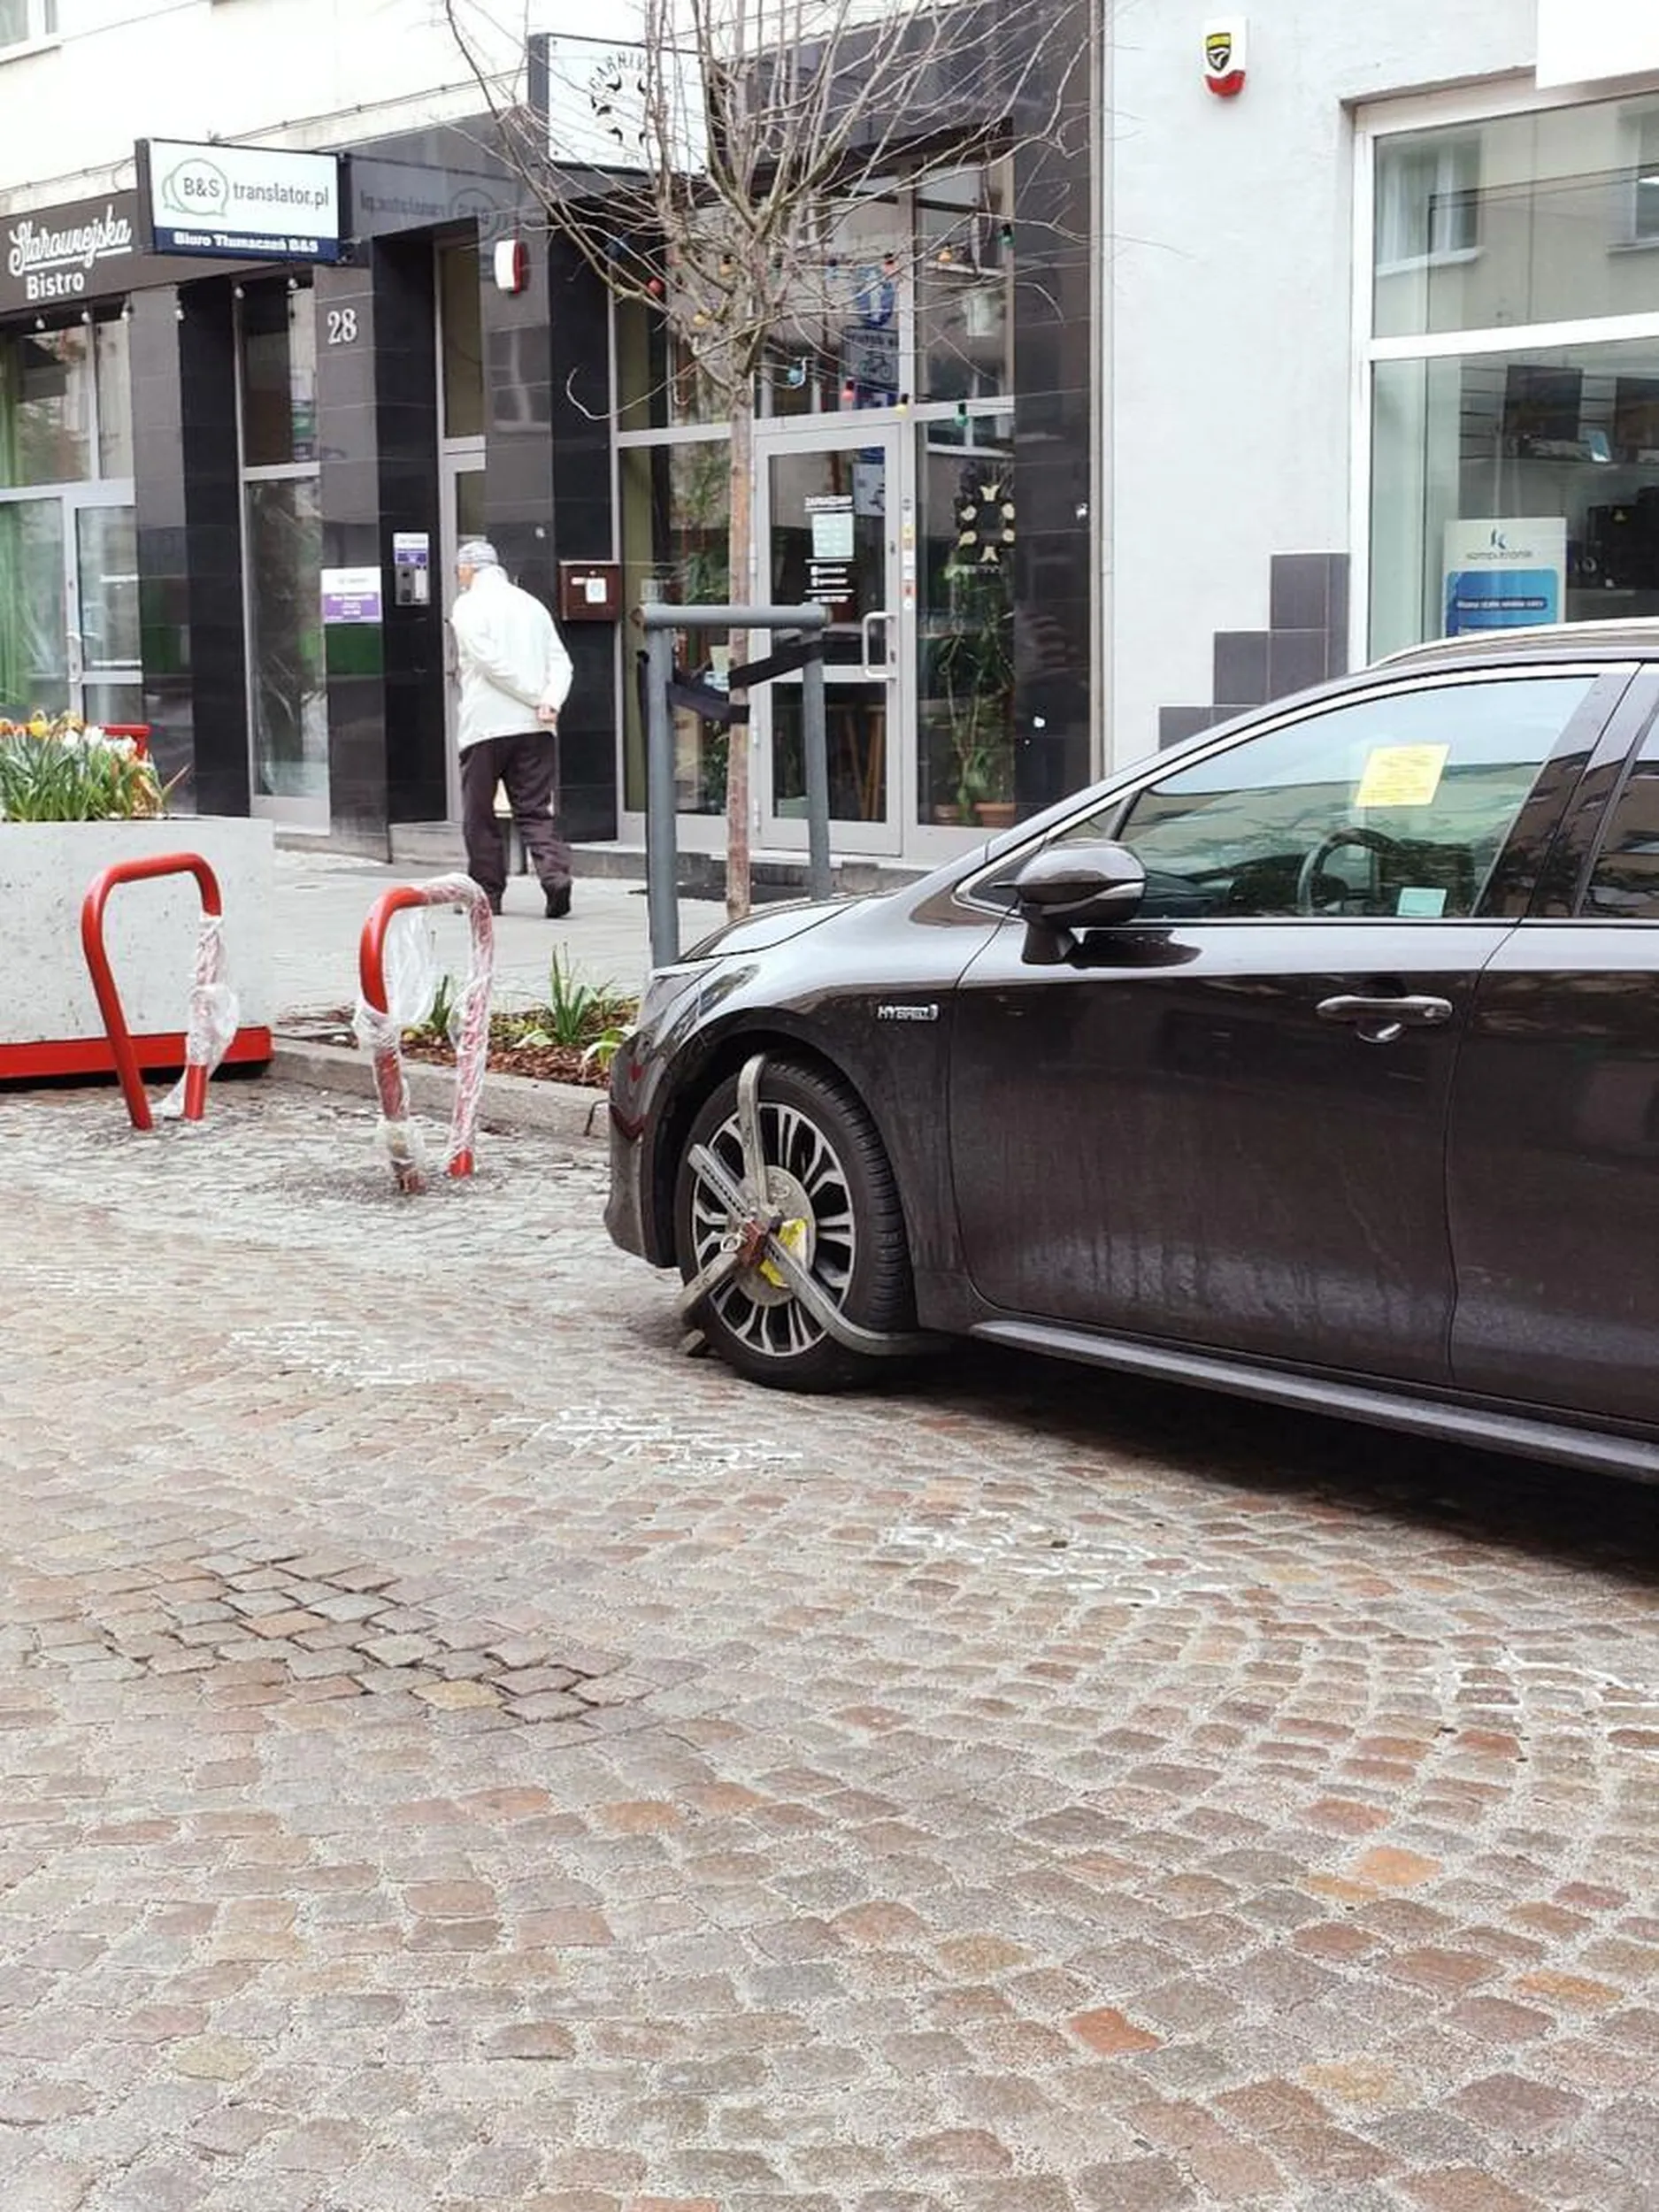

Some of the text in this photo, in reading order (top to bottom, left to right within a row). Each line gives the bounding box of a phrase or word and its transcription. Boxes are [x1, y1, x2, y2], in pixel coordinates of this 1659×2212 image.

[182, 176, 329, 210] B&S translator.pl
[173, 230, 211, 246] Biuro
[26, 272, 85, 300] Bistro
[327, 308, 357, 344] 28
